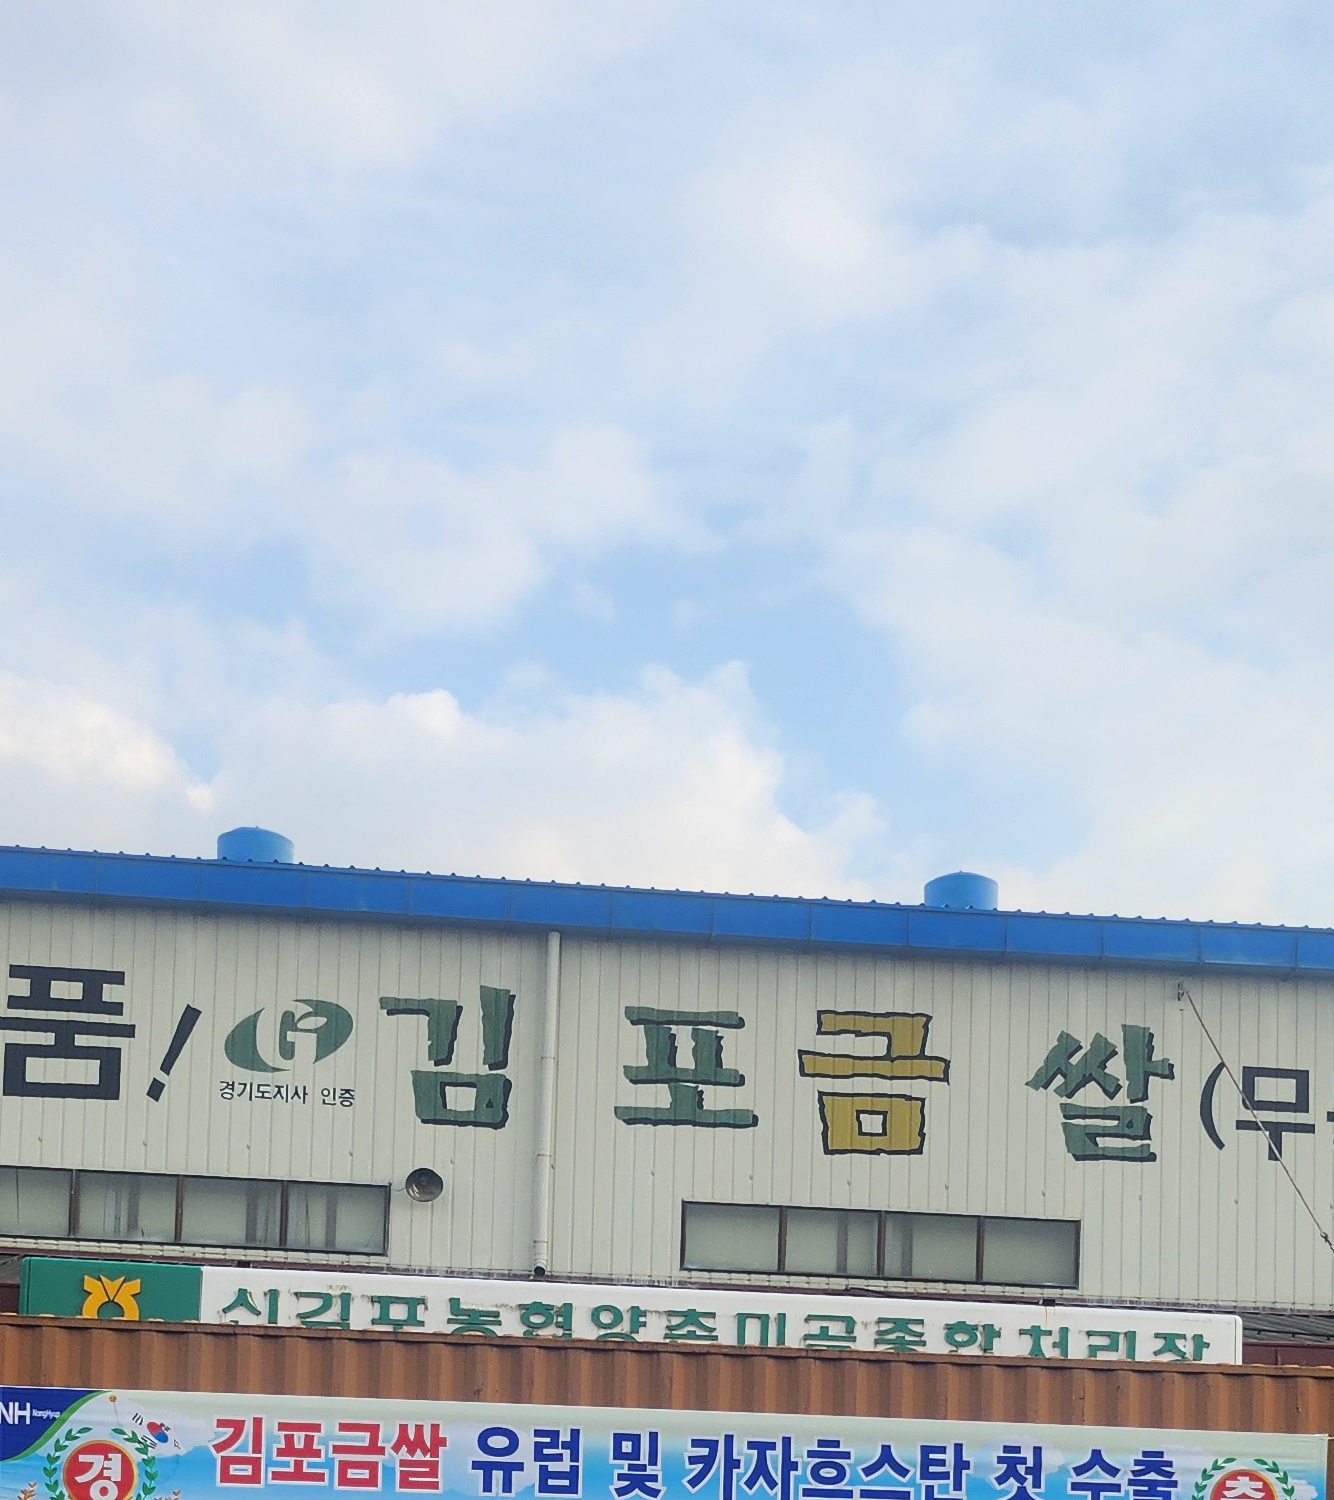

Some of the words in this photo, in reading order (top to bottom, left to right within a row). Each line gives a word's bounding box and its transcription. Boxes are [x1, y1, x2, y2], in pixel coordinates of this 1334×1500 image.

[218, 1080, 308, 1106] 경기도지사
[320, 1085, 355, 1109] 인증
[211, 1415, 447, 1492] 김포금쌀
[473, 1425, 582, 1497] 유럽
[609, 1430, 663, 1500] 및
